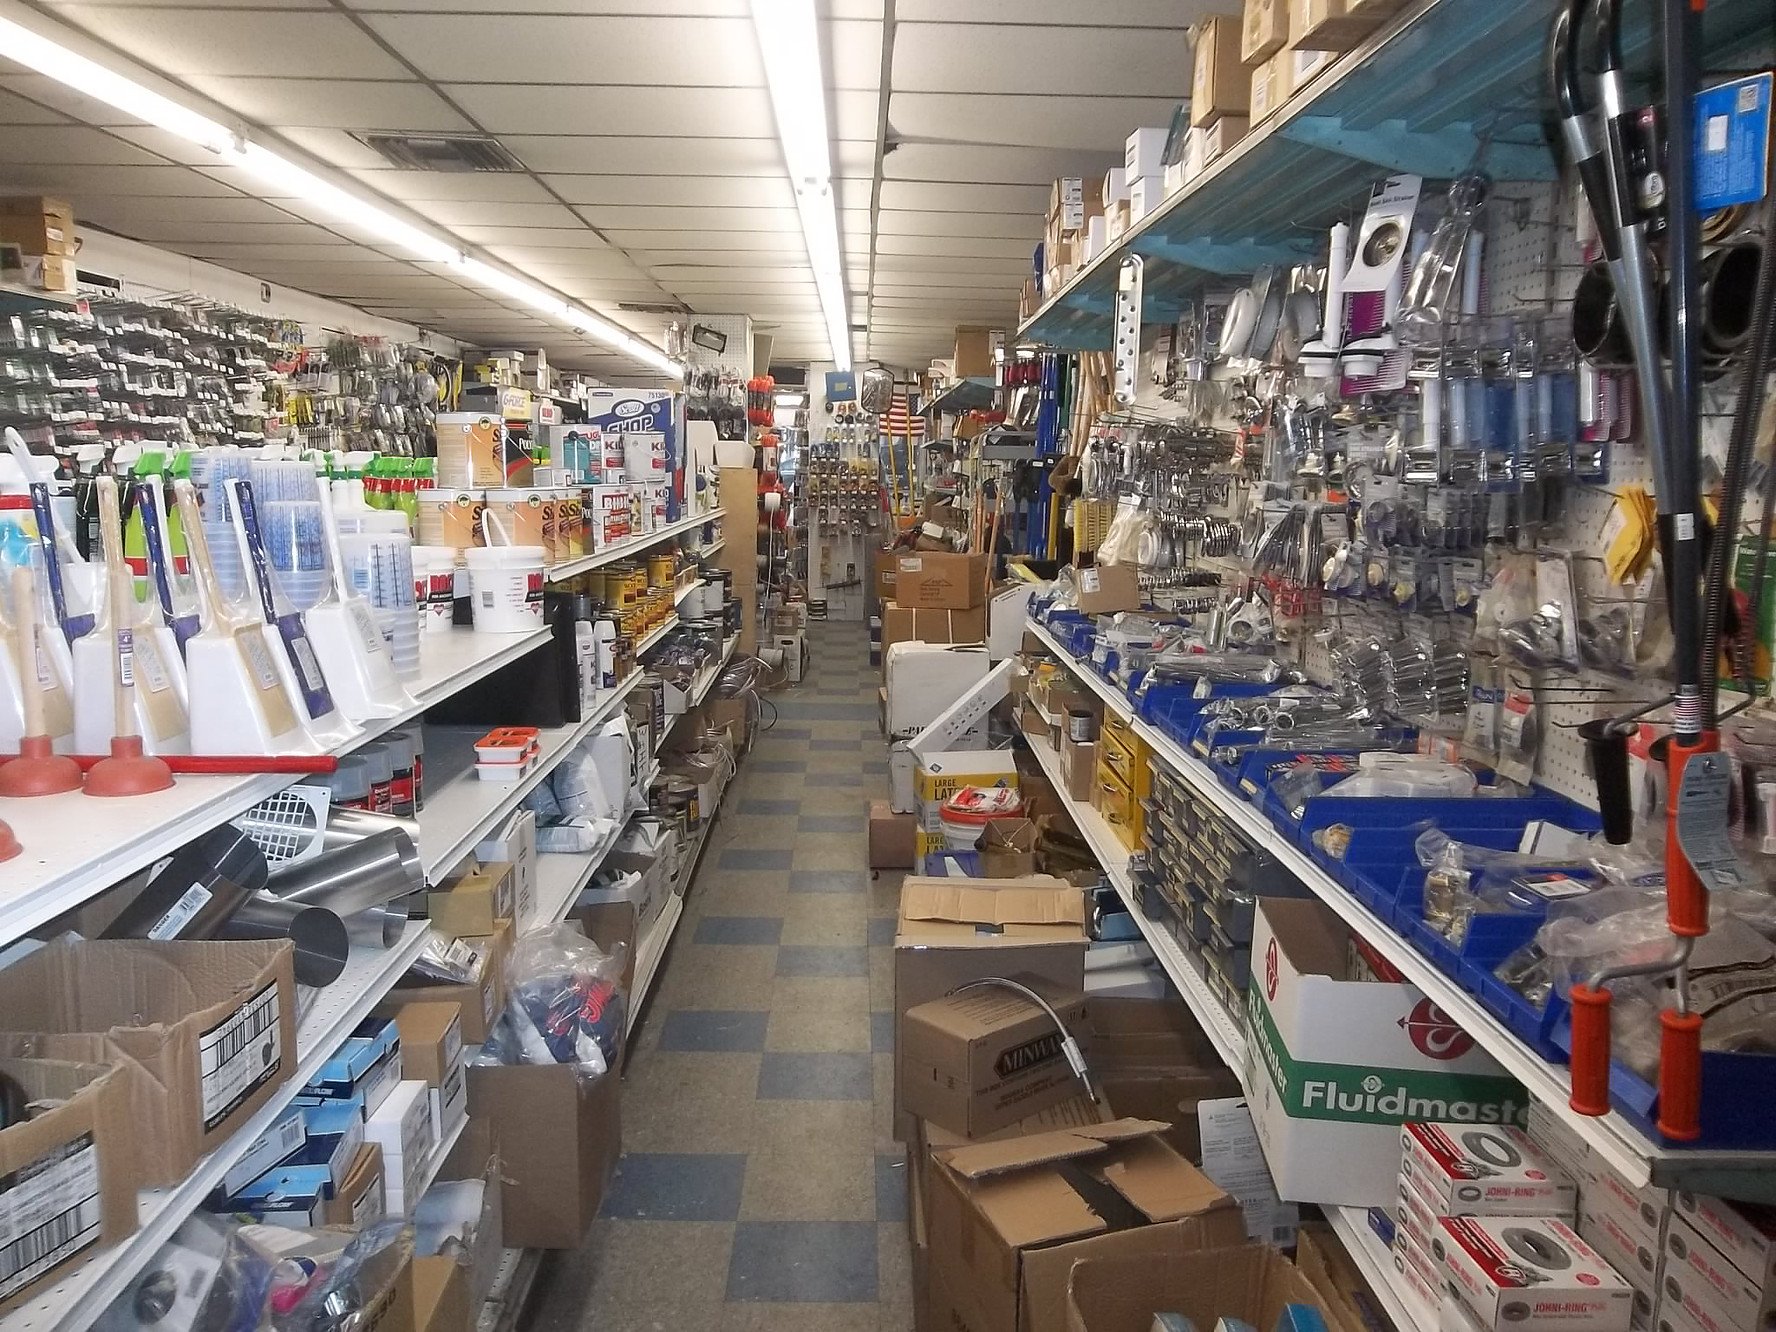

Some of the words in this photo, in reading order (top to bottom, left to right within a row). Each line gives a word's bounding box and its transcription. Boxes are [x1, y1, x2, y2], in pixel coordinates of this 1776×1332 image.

[934, 779, 956, 787] LARGE
[934, 787, 961, 801] LATE
[1002, 1033, 1066, 1075] MINWA
[1248, 988, 1288, 1094] Fluidmaster
[1302, 1075, 1529, 1125] Fluidmaste
